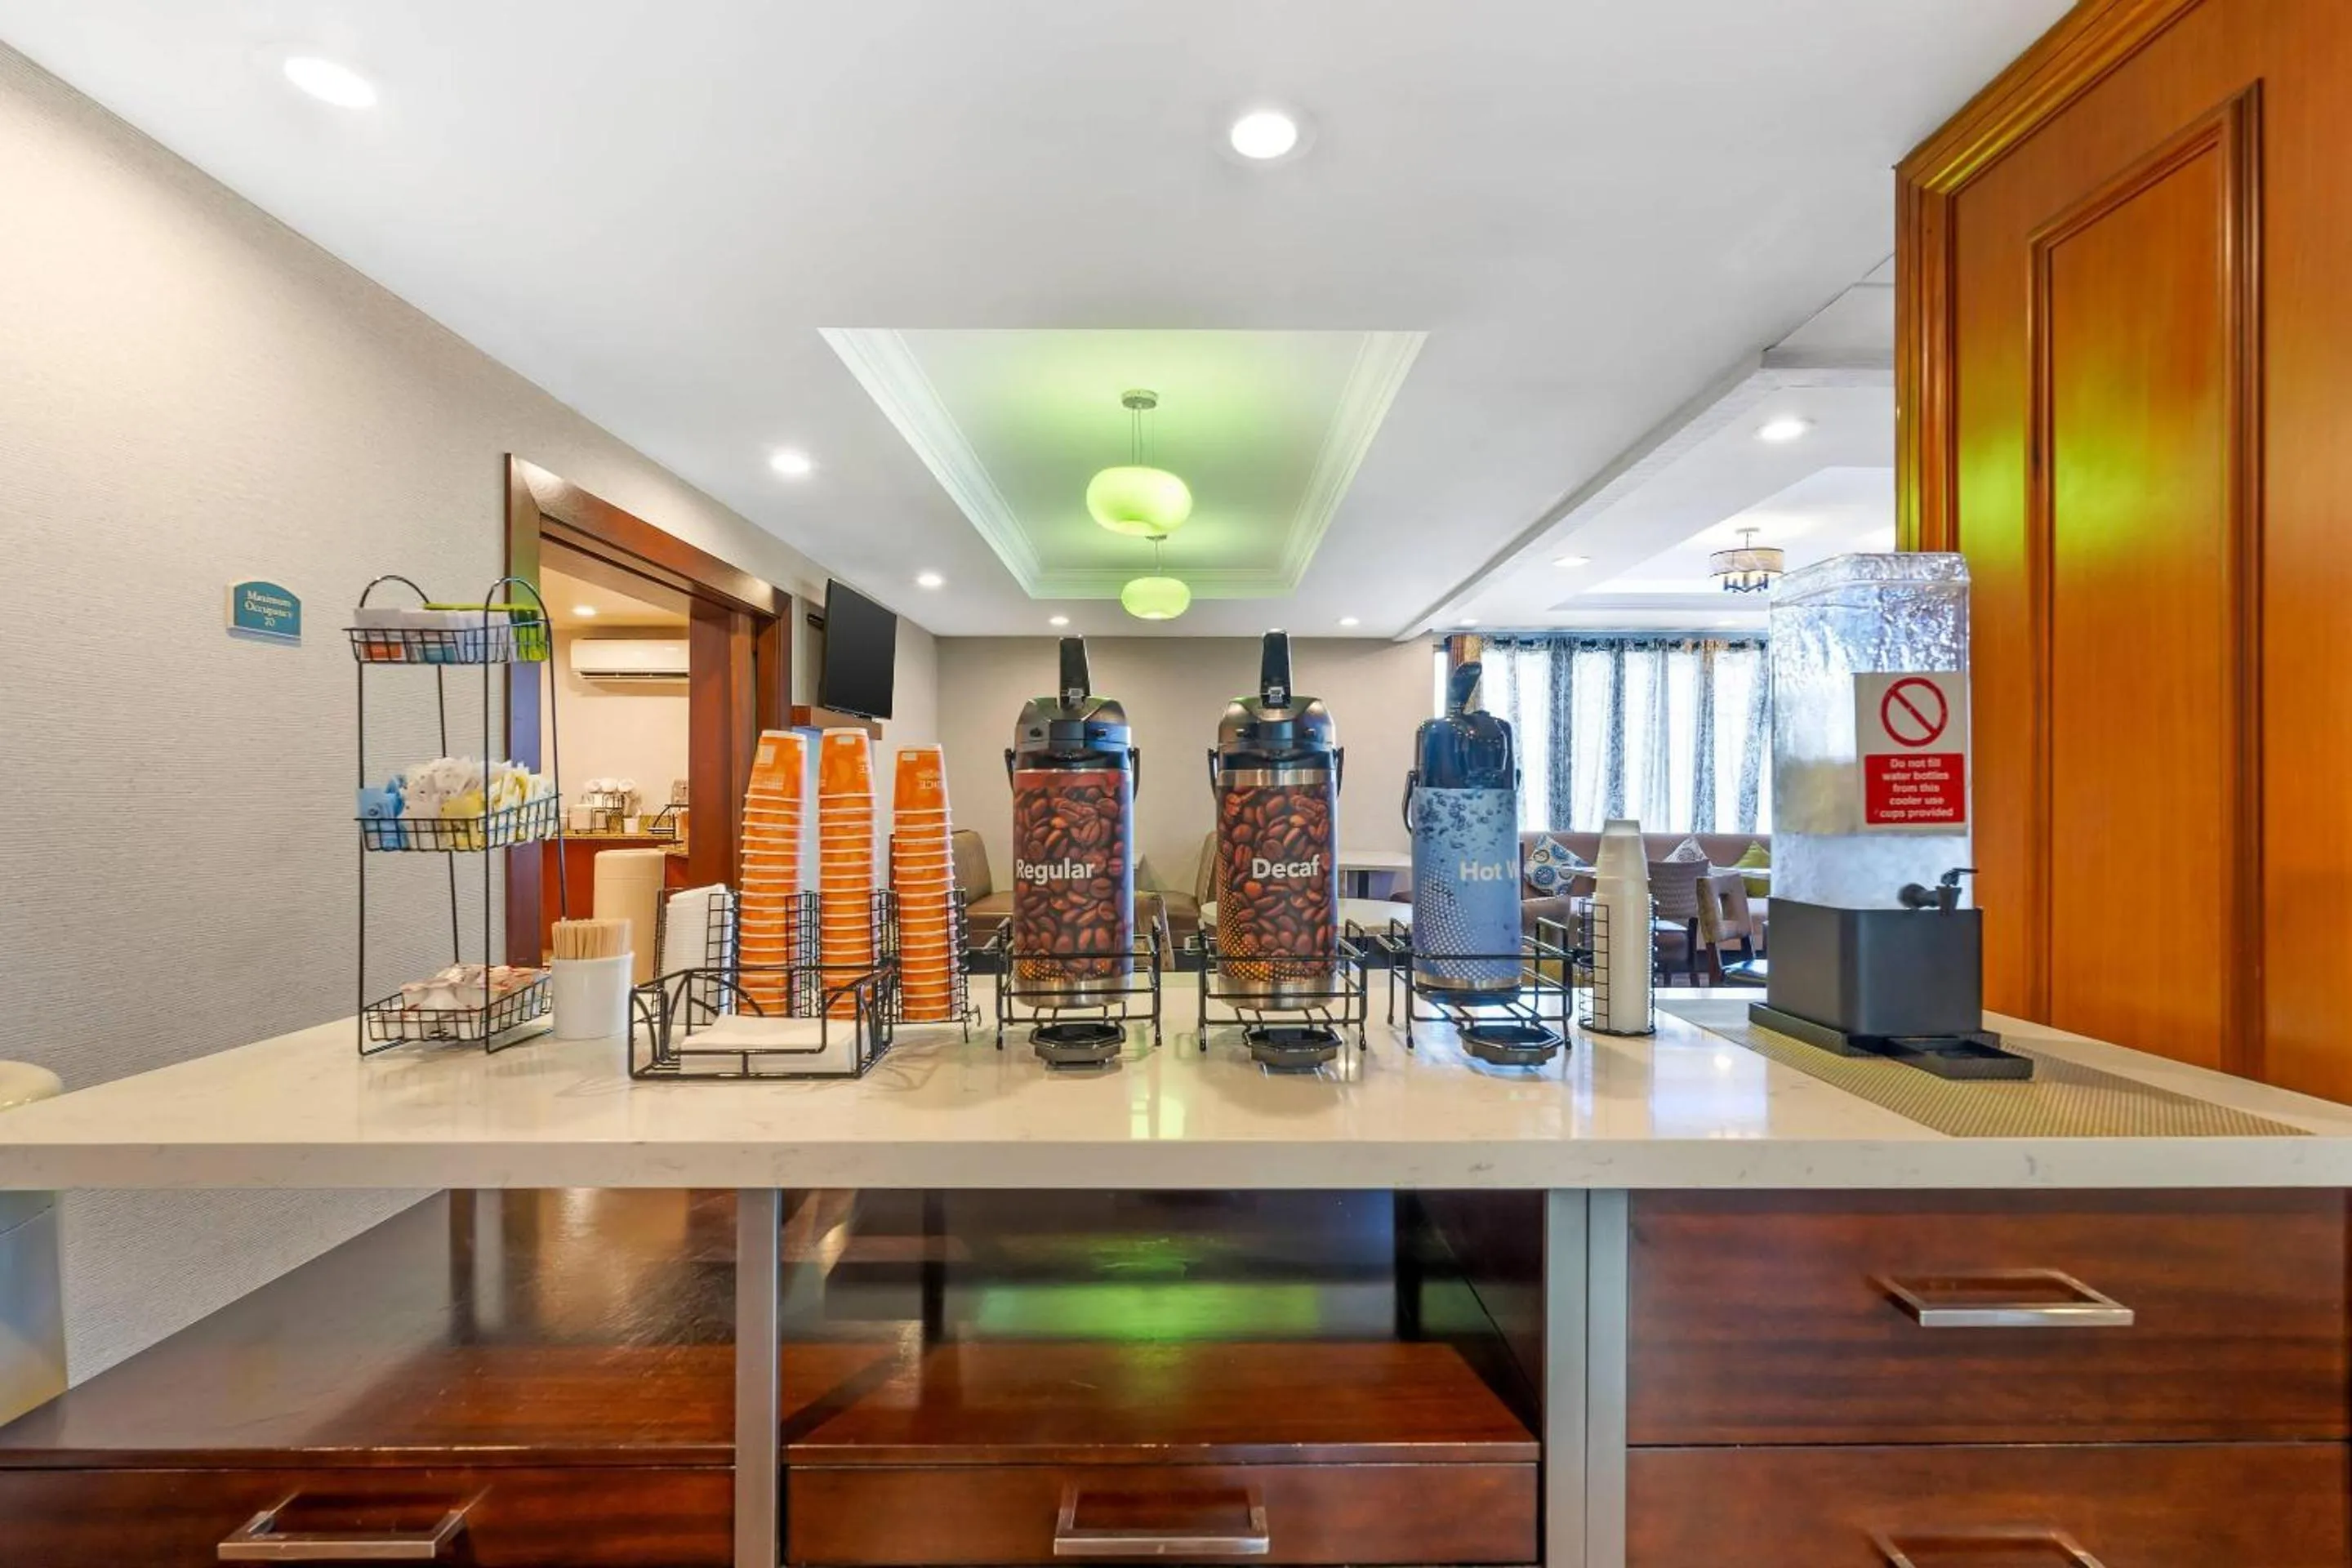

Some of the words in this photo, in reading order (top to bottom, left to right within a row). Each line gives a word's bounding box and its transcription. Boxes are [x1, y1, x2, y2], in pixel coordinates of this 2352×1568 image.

[1890, 758, 1906, 768] Do
[1907, 759, 1926, 768] not
[1927, 757, 1941, 768] fill
[1882, 772, 1911, 781] water
[1913, 771, 1949, 781] bottles
[1892, 783, 1918, 793] from
[1919, 783, 1940, 793] this
[1889, 795, 1922, 805] cooler
[1923, 796, 1944, 805] use
[1880, 809, 1906, 820] cups
[1907, 807, 1954, 819] provided
[1016, 857, 1096, 885] Regular
[1251, 854, 1321, 880] Decaf
[1459, 860, 1503, 882] Hot
